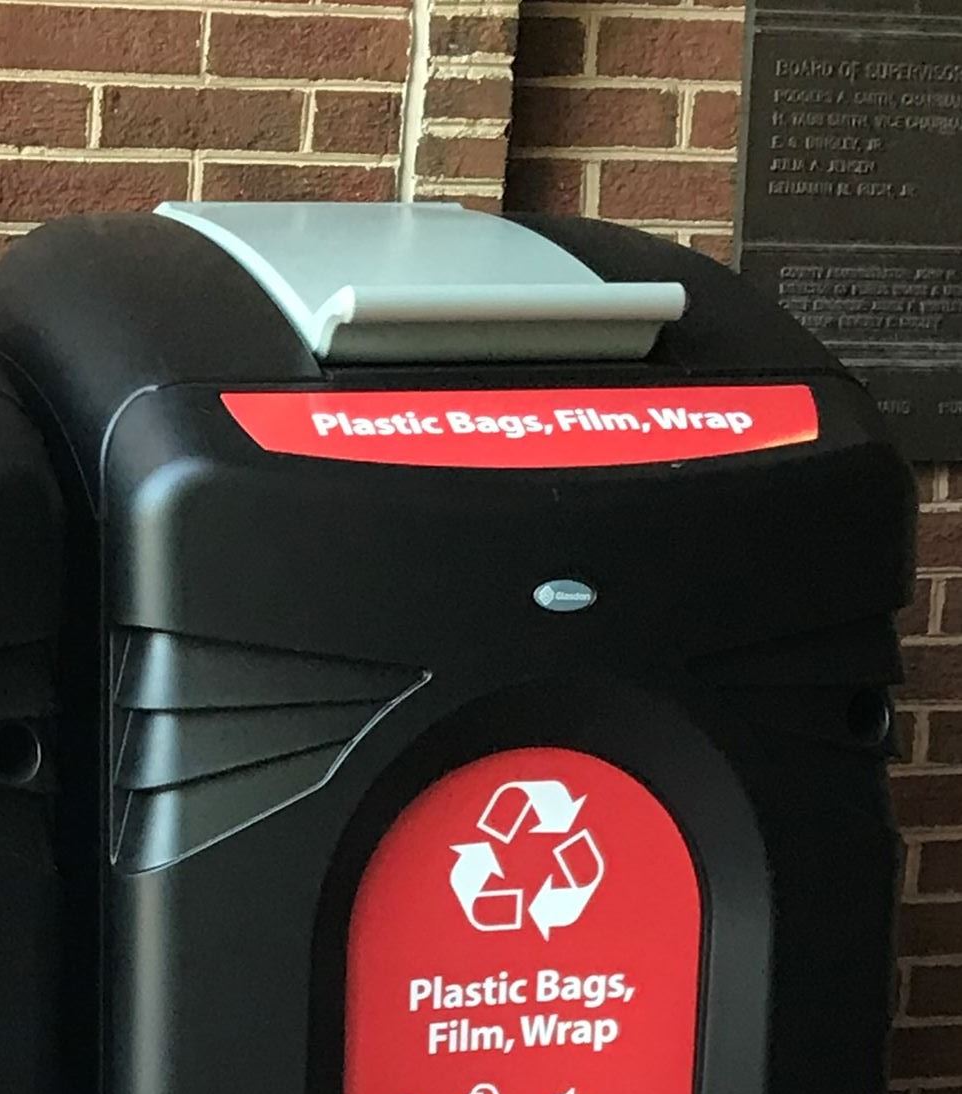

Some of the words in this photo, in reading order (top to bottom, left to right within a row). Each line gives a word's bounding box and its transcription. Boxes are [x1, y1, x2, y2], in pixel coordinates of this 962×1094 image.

[776, 59, 834, 77] BOARD
[838, 61, 860, 79] OF
[311, 411, 444, 437] Plastic
[445, 409, 554, 439] Bags,
[553, 408, 650, 434] Film,
[649, 407, 754, 435] Wrap
[409, 971, 528, 1012] Plastic
[536, 968, 636, 1008] Bags,
[428, 1018, 515, 1055] Film,
[519, 1014, 619, 1053] Wrap
